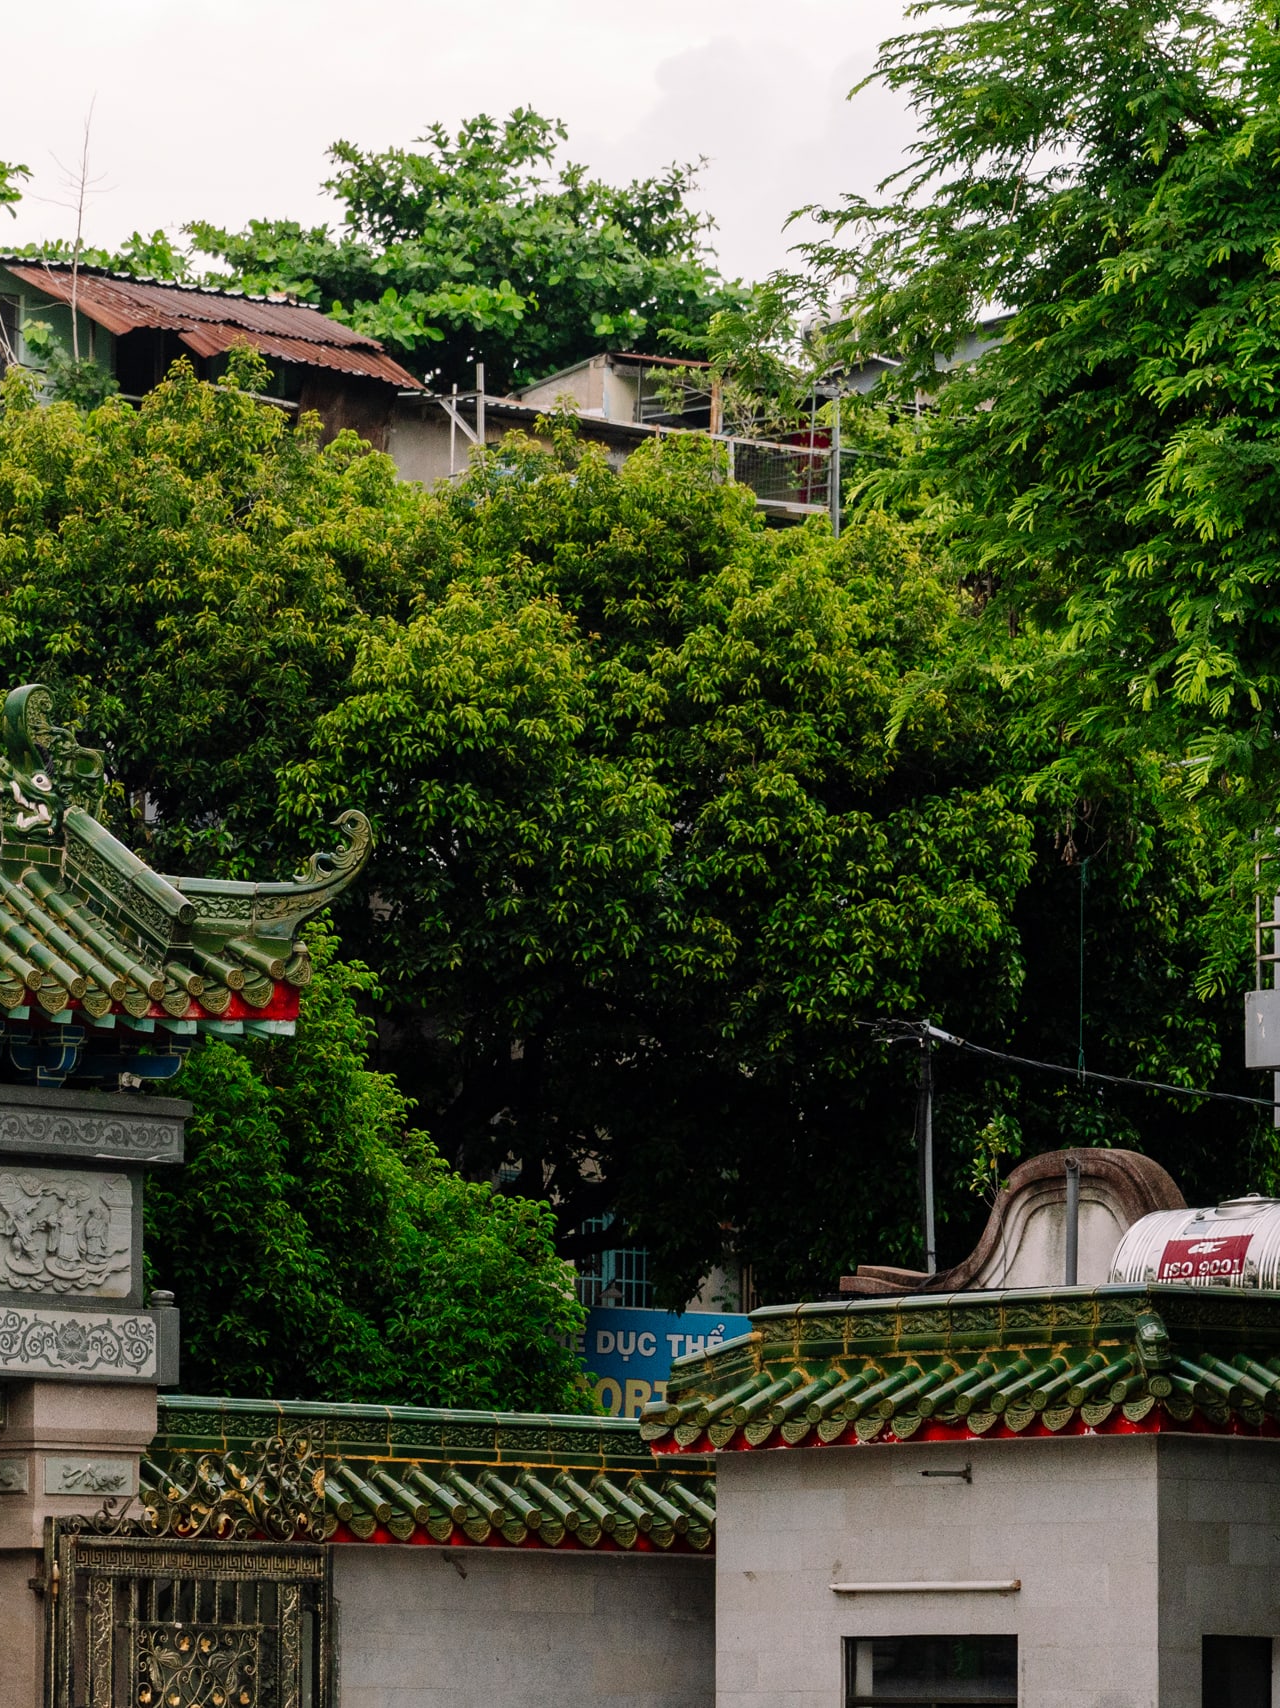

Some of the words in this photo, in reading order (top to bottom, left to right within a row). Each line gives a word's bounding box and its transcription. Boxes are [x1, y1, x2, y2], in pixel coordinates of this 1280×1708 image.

[1163, 1261, 1194, 1278] ISO
[1198, 1258, 1241, 1276] 9001
[595, 1330, 658, 1362] DỤC
